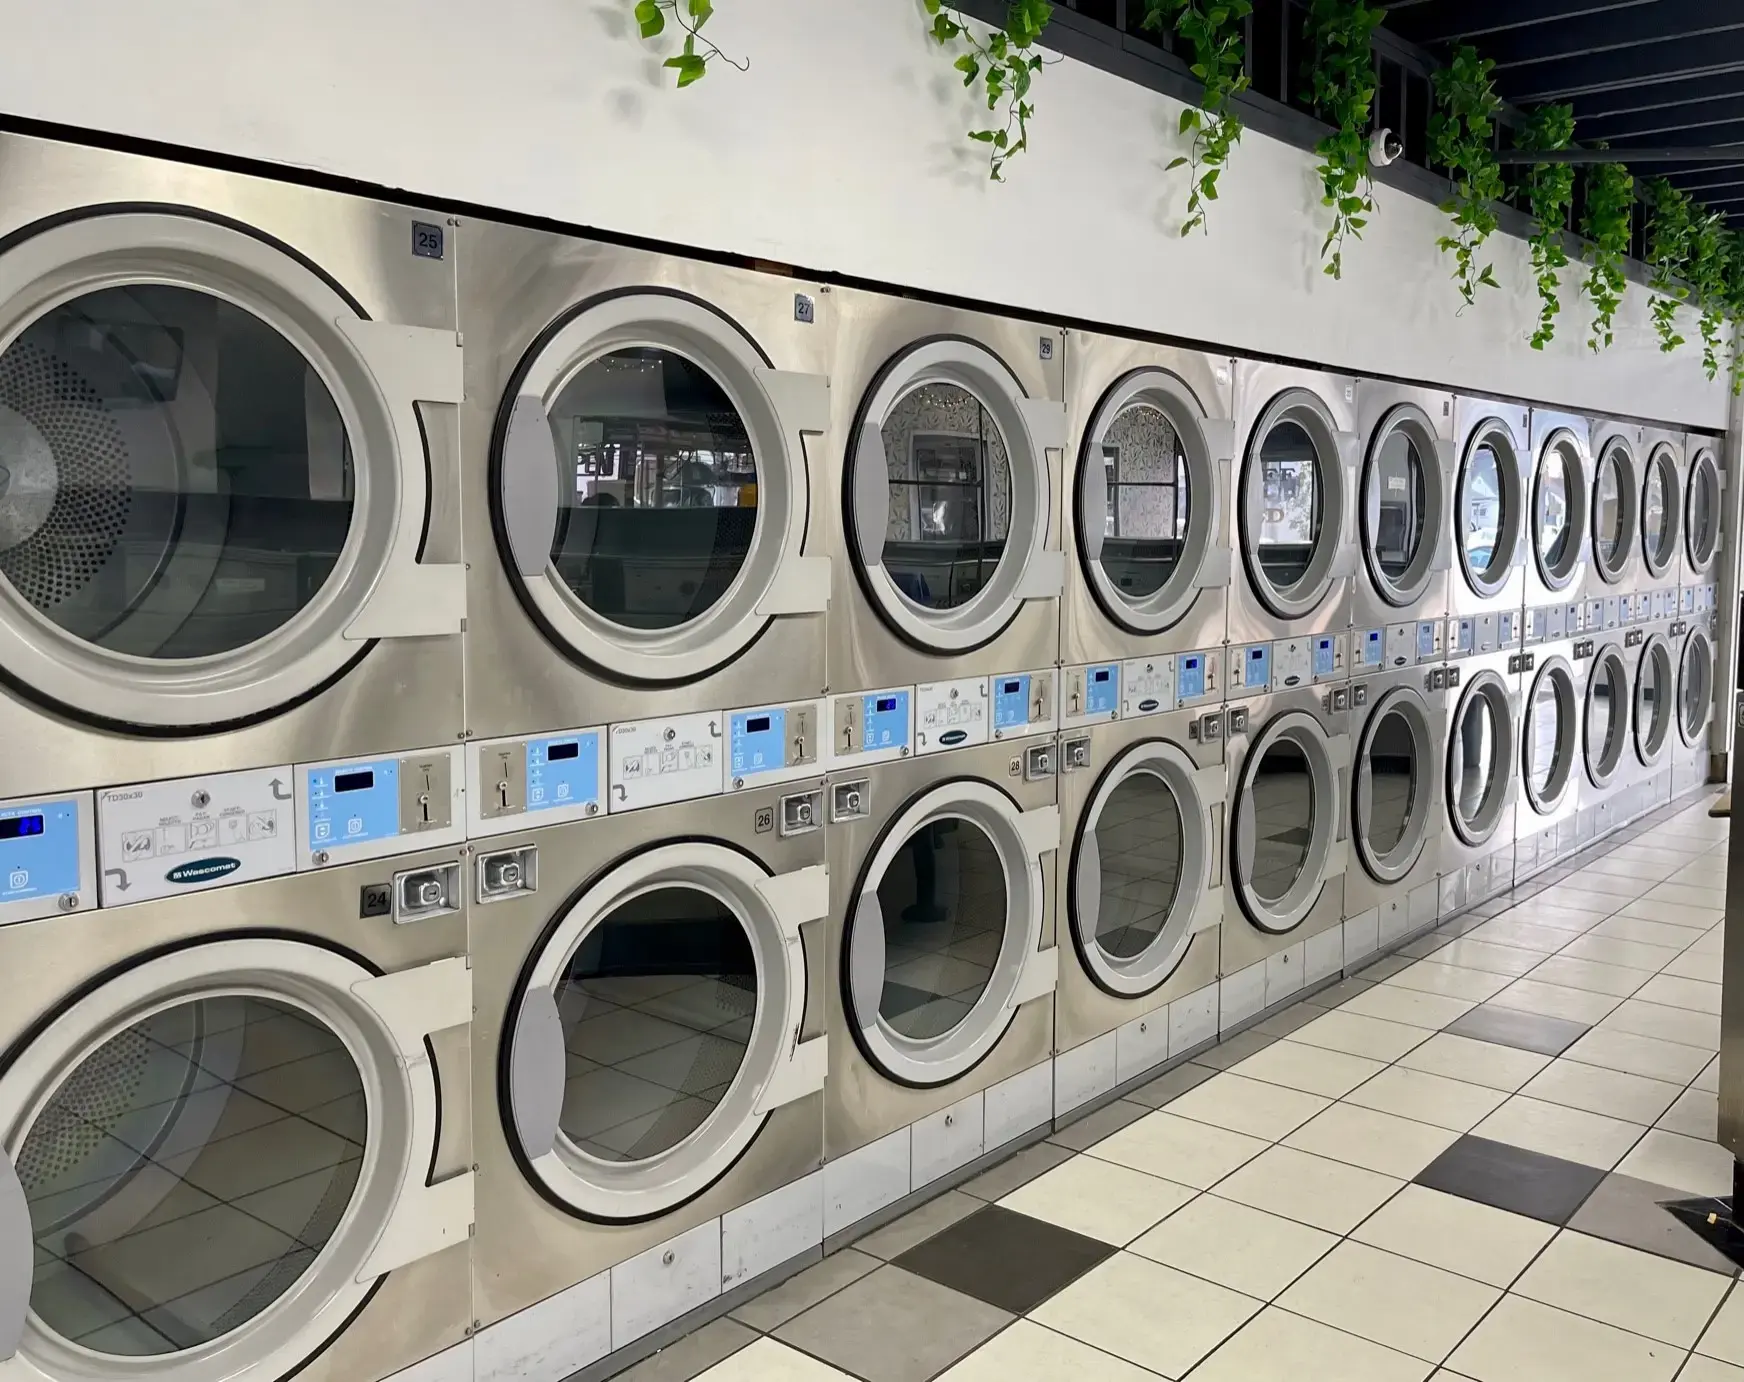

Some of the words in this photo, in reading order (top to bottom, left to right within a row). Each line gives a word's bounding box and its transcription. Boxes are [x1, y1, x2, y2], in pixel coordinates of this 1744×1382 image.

[418, 231, 438, 249] 25
[797, 302, 811, 315] 27
[1041, 343, 1051, 354] 29
[1010, 760, 1020, 771] 28
[107, 790, 143, 803] TD30x30
[757, 813, 771, 827] 26
[182, 862, 236, 878] Wascomat
[367, 890, 388, 909] 24
